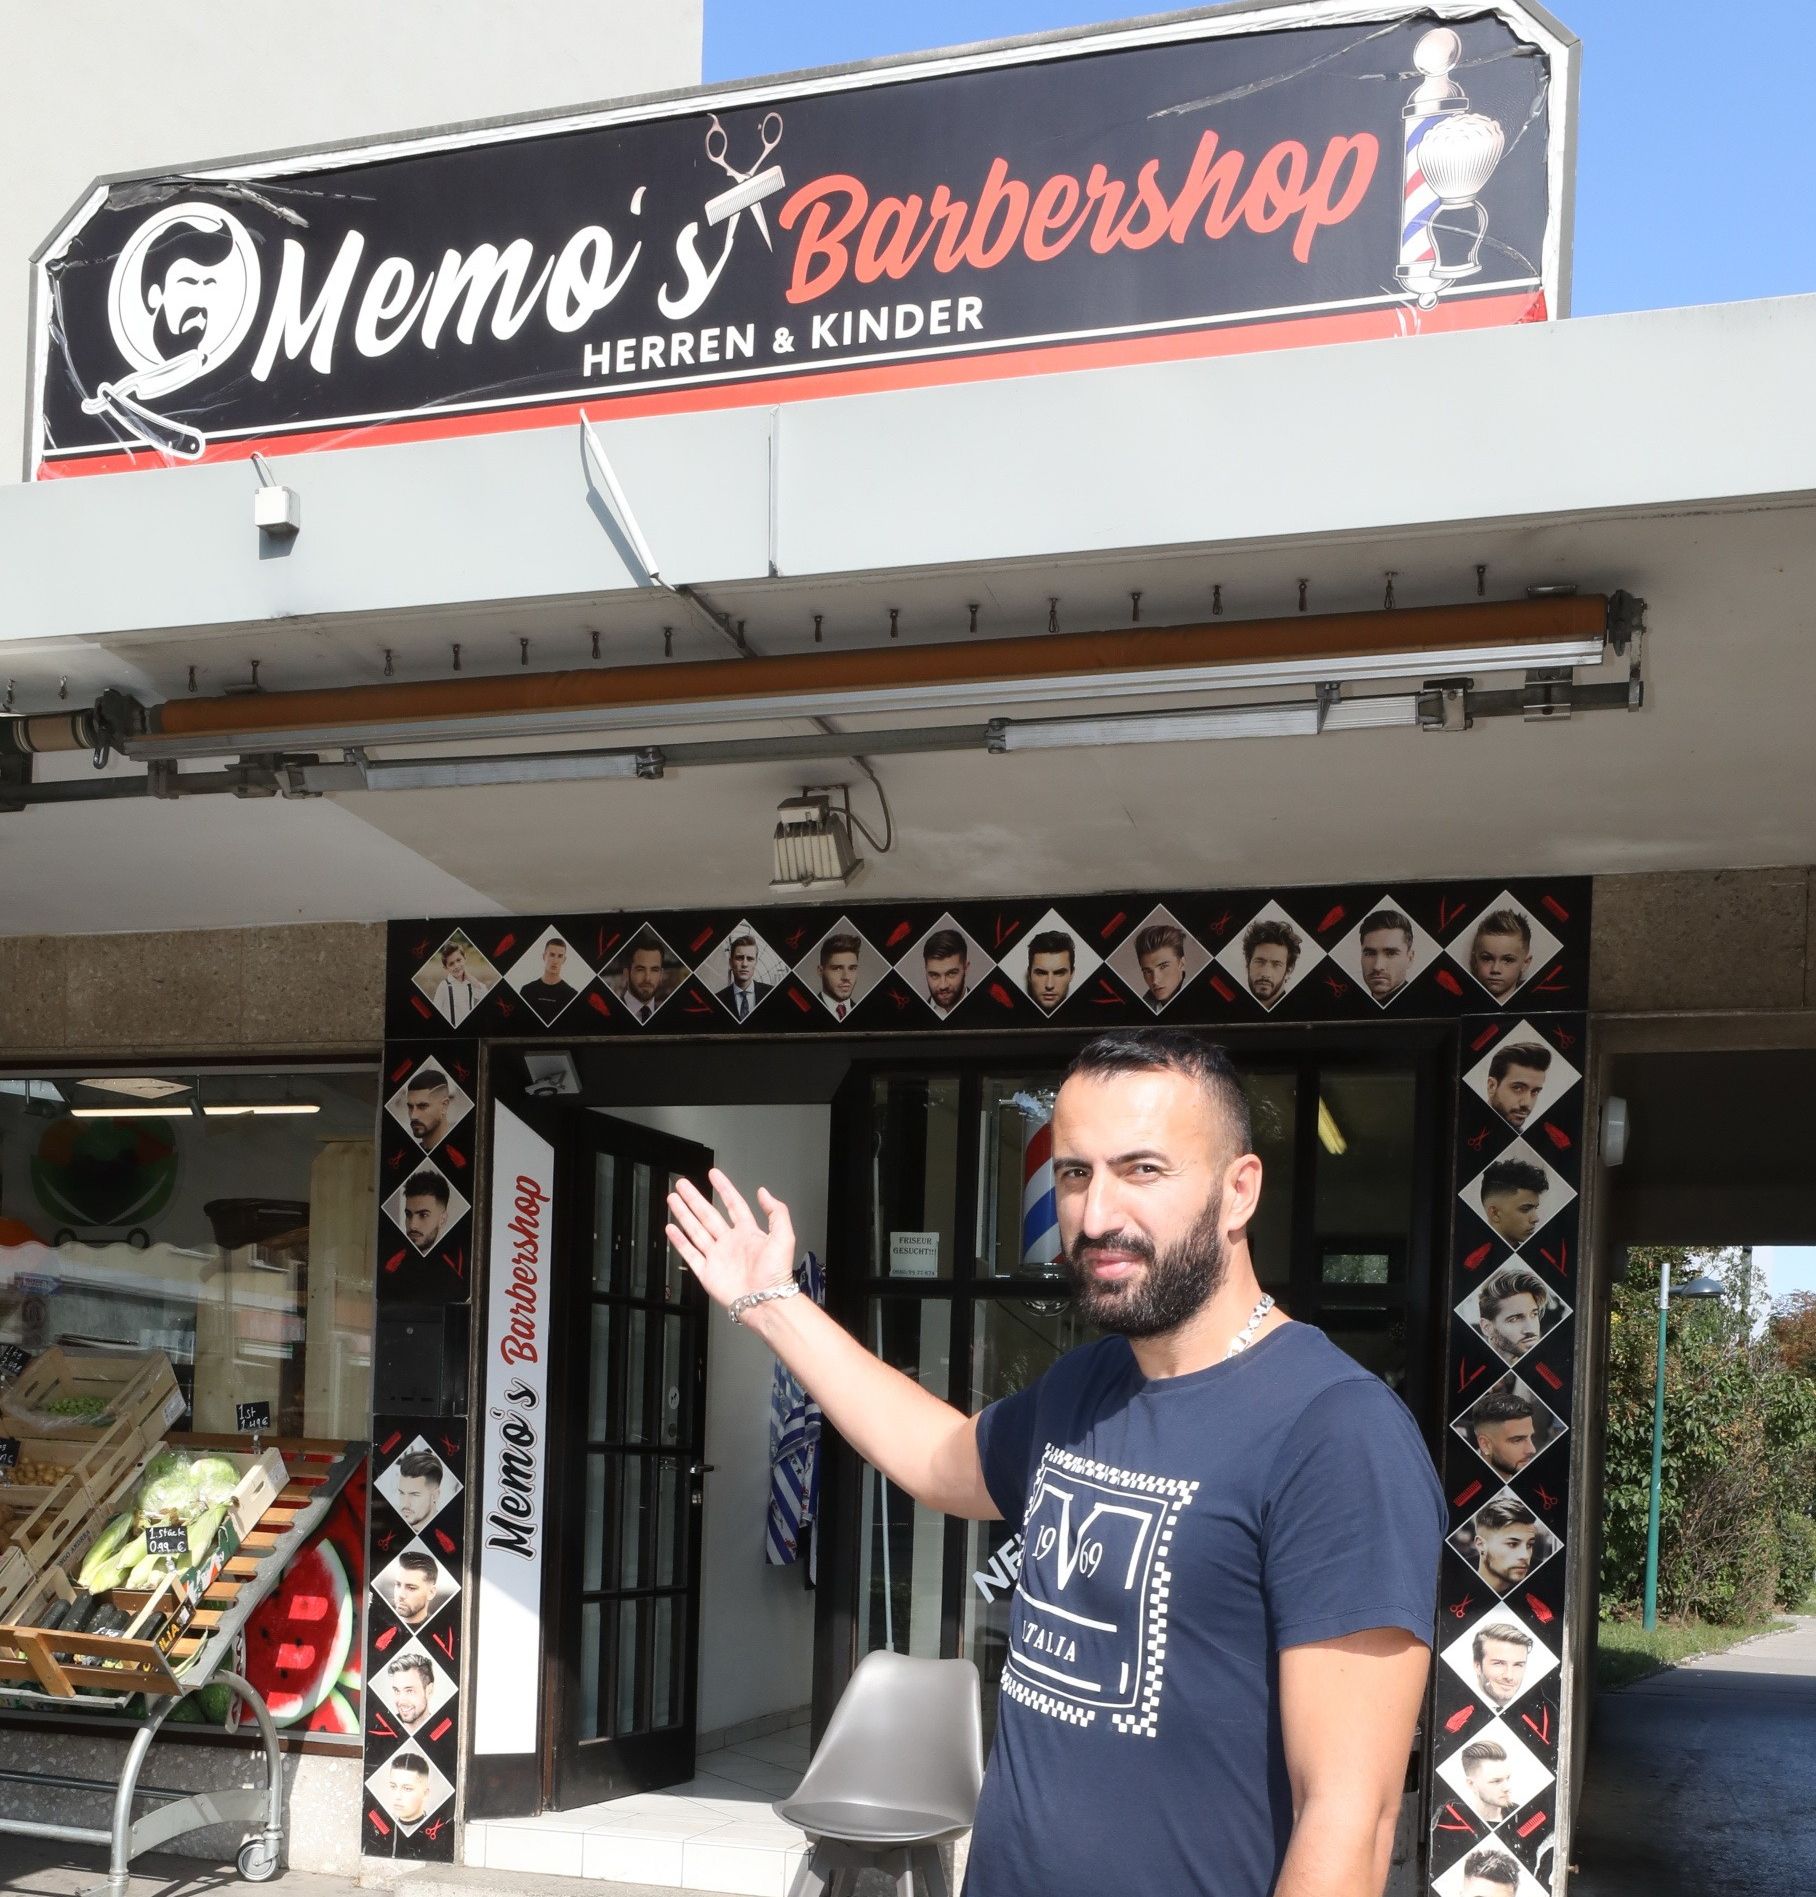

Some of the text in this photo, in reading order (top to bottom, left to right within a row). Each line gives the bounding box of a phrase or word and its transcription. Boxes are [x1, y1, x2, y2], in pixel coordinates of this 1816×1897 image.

[251, 130, 1379, 381] Memo's Barbershop
[583, 296, 983, 376] HERREN & KINDER
[899, 1237, 932, 1245] FRISEUR
[486, 1175, 550, 1560] Memo's Barbershop
[972, 1533, 1021, 1604] NE
[1032, 1525, 1056, 1560] 19
[1079, 1538, 1102, 1578] 69
